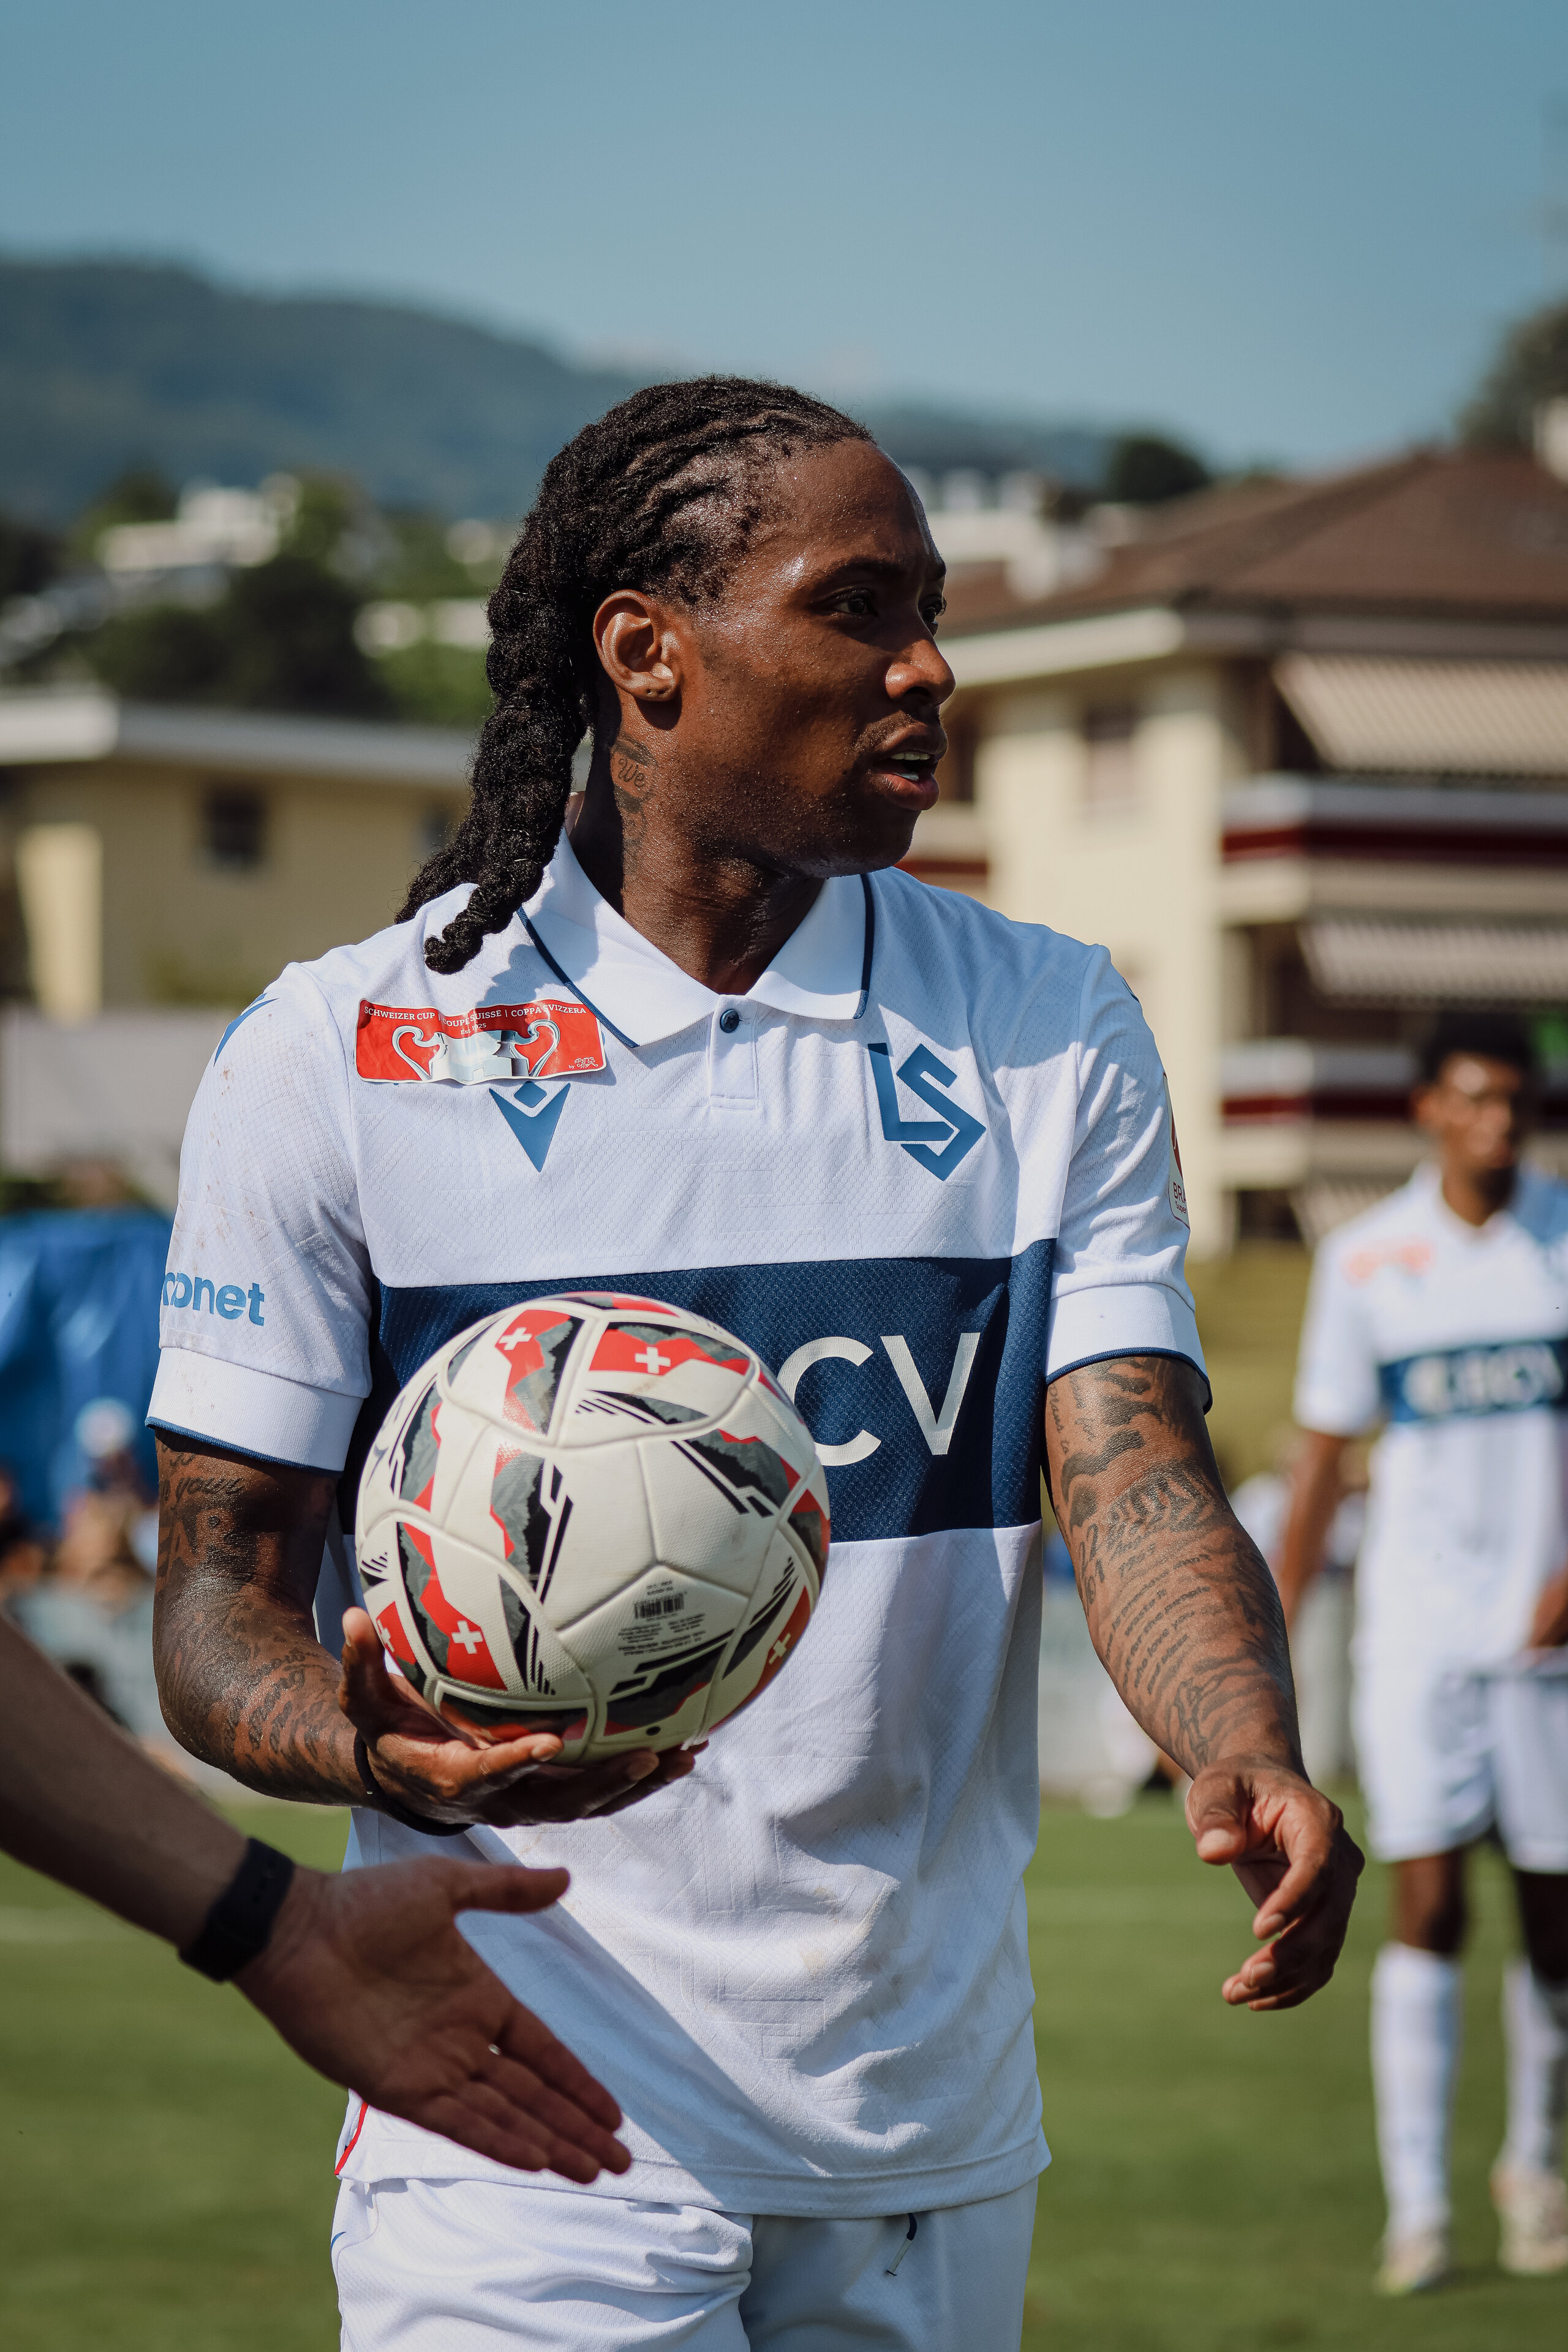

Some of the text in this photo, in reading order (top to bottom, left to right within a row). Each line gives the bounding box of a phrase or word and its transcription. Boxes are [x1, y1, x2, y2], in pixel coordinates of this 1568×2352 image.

[364, 1004, 587, 1027] SCHWEIZER CUP COUPE SUISSE COPPA SVIZZERA
[867, 1042, 987, 1182] LS
[1164, 1586, 1211, 1615] people
[1147, 1628, 1169, 1656] love
